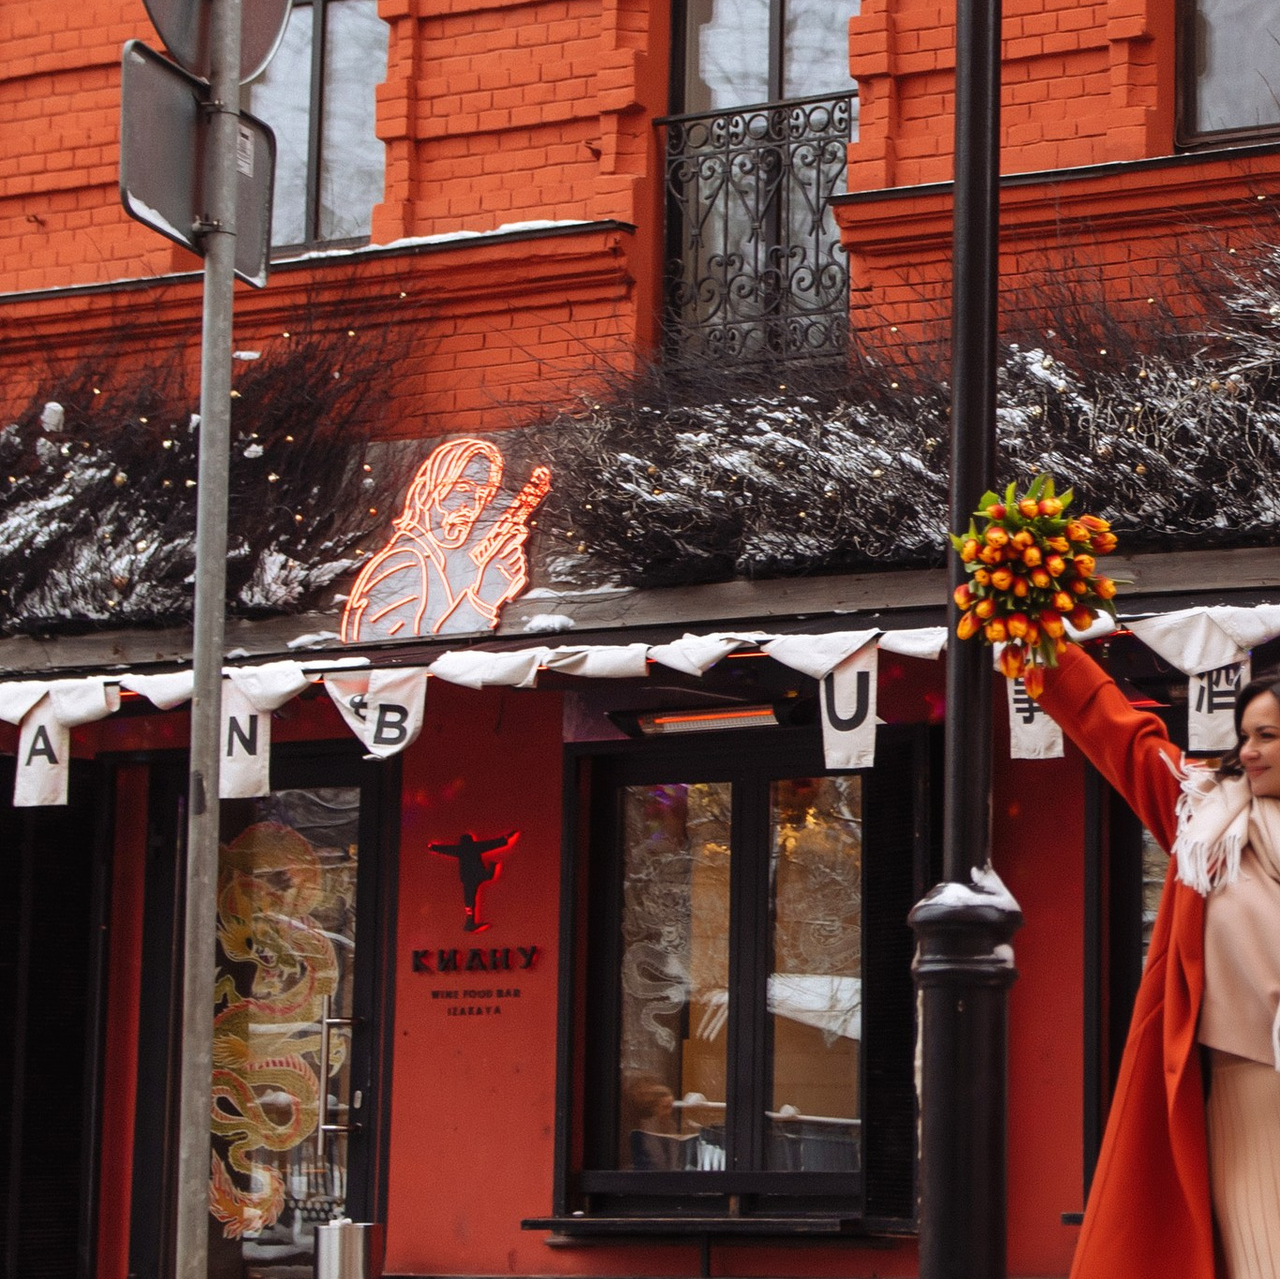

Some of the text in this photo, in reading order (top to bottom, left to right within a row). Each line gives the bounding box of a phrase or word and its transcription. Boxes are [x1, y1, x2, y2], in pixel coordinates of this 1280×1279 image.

[25, 725, 59, 766] A
[226, 714, 258, 757] N
[373, 703, 409, 745] B
[824, 670, 870, 732] U
[412, 945, 537, 974] КИАНУ
[463, 989, 493, 999] FOOD
